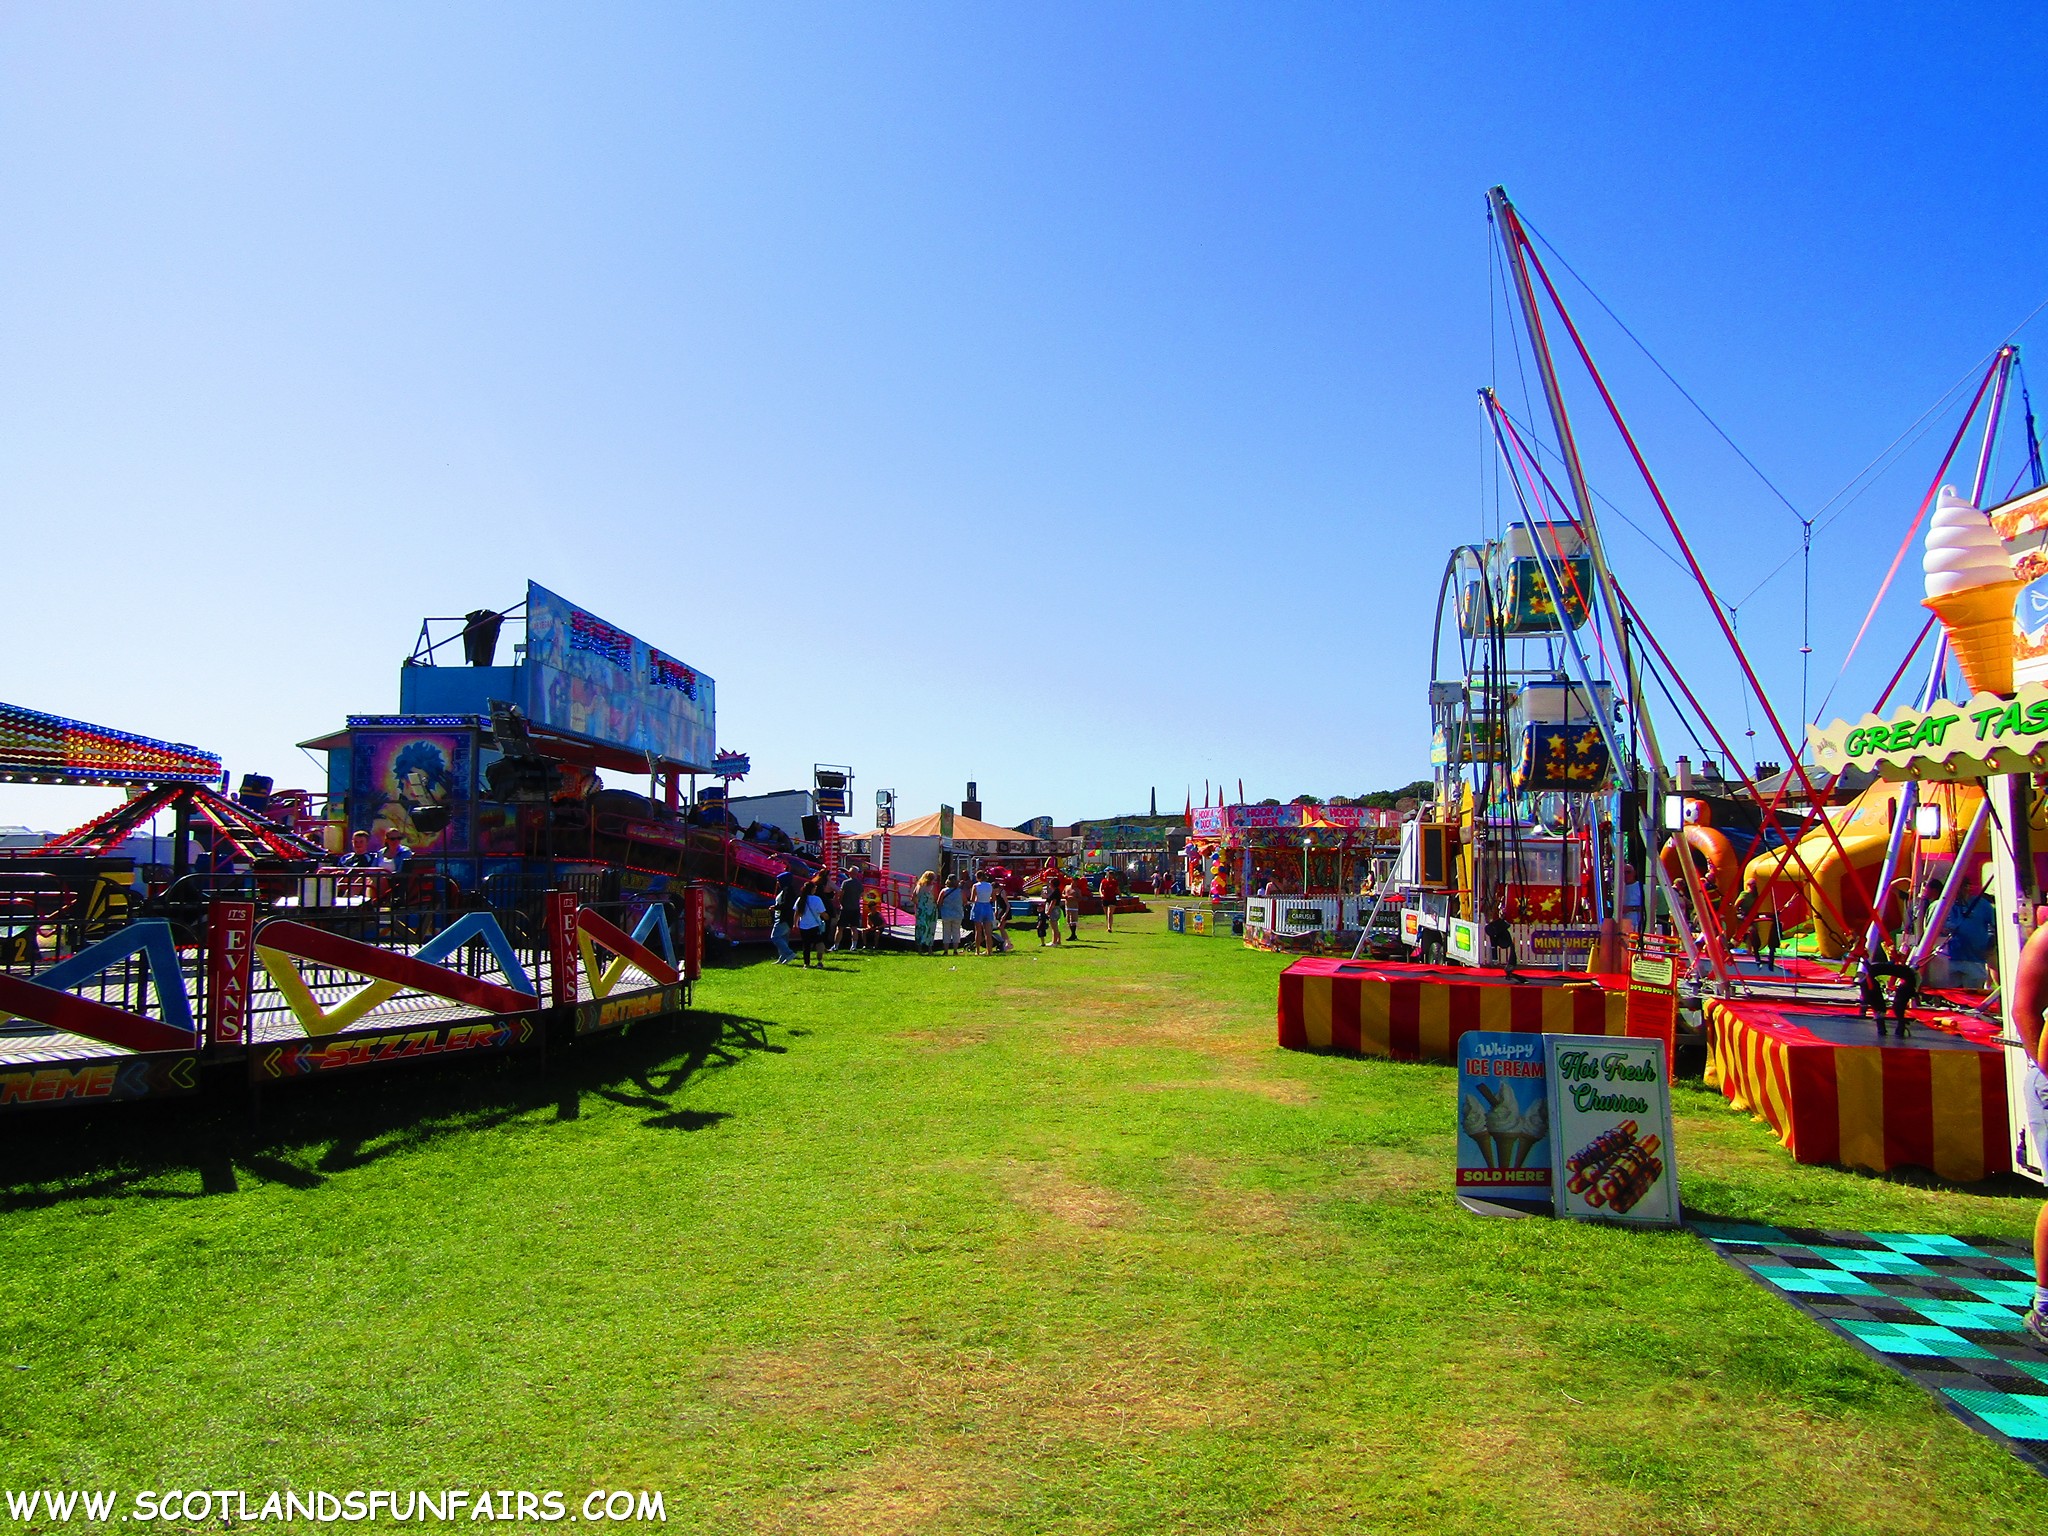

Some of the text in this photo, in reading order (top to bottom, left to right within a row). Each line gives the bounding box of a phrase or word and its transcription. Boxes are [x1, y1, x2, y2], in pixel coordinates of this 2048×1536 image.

[1844, 714, 1959, 757] GREAT
[1246, 806, 1284, 818] HOOK A
[1251, 817, 1279, 827] DUCK
[1329, 807, 1365, 818] HOOK A
[1534, 937, 1561, 949] MINI
[562, 914, 577, 1002] EVANS
[221, 908, 247, 1039] IT'S EVANS
[599, 993, 663, 1025] EXTREME
[320, 1023, 496, 1070] SIZZLER
[1475, 1042, 1535, 1058] Whippy
[1466, 1058, 1545, 1078] ICE CREAM
[1559, 1051, 1656, 1083] Hot Fresh
[1569, 1083, 1648, 1113] Churros
[1463, 1171, 1545, 1182] SOLD HERE
